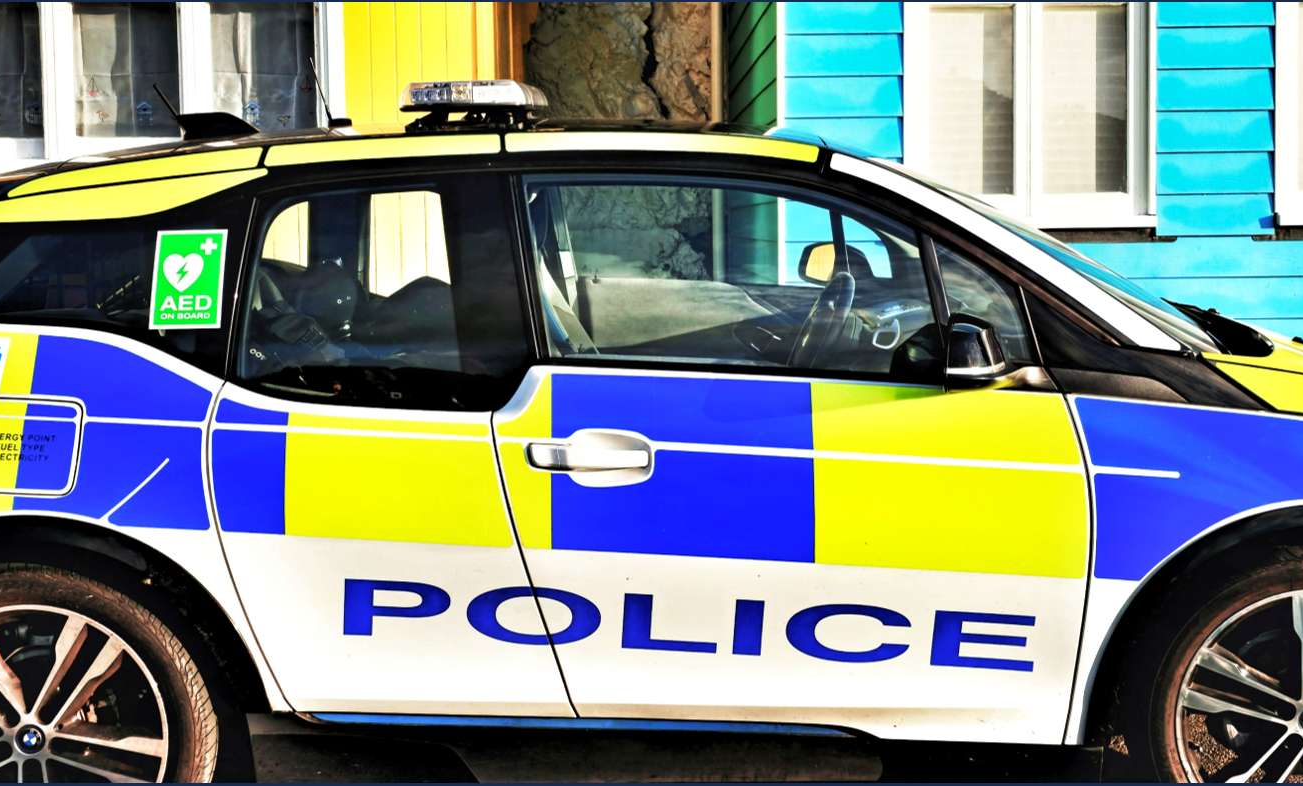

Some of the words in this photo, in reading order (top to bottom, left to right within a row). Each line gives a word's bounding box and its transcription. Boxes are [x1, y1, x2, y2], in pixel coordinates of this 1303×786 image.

[160, 295, 212, 311] AED
[28, 434, 56, 442] POINT
[22, 444, 45, 452] TYPE
[343, 578, 1035, 672] POLICE
